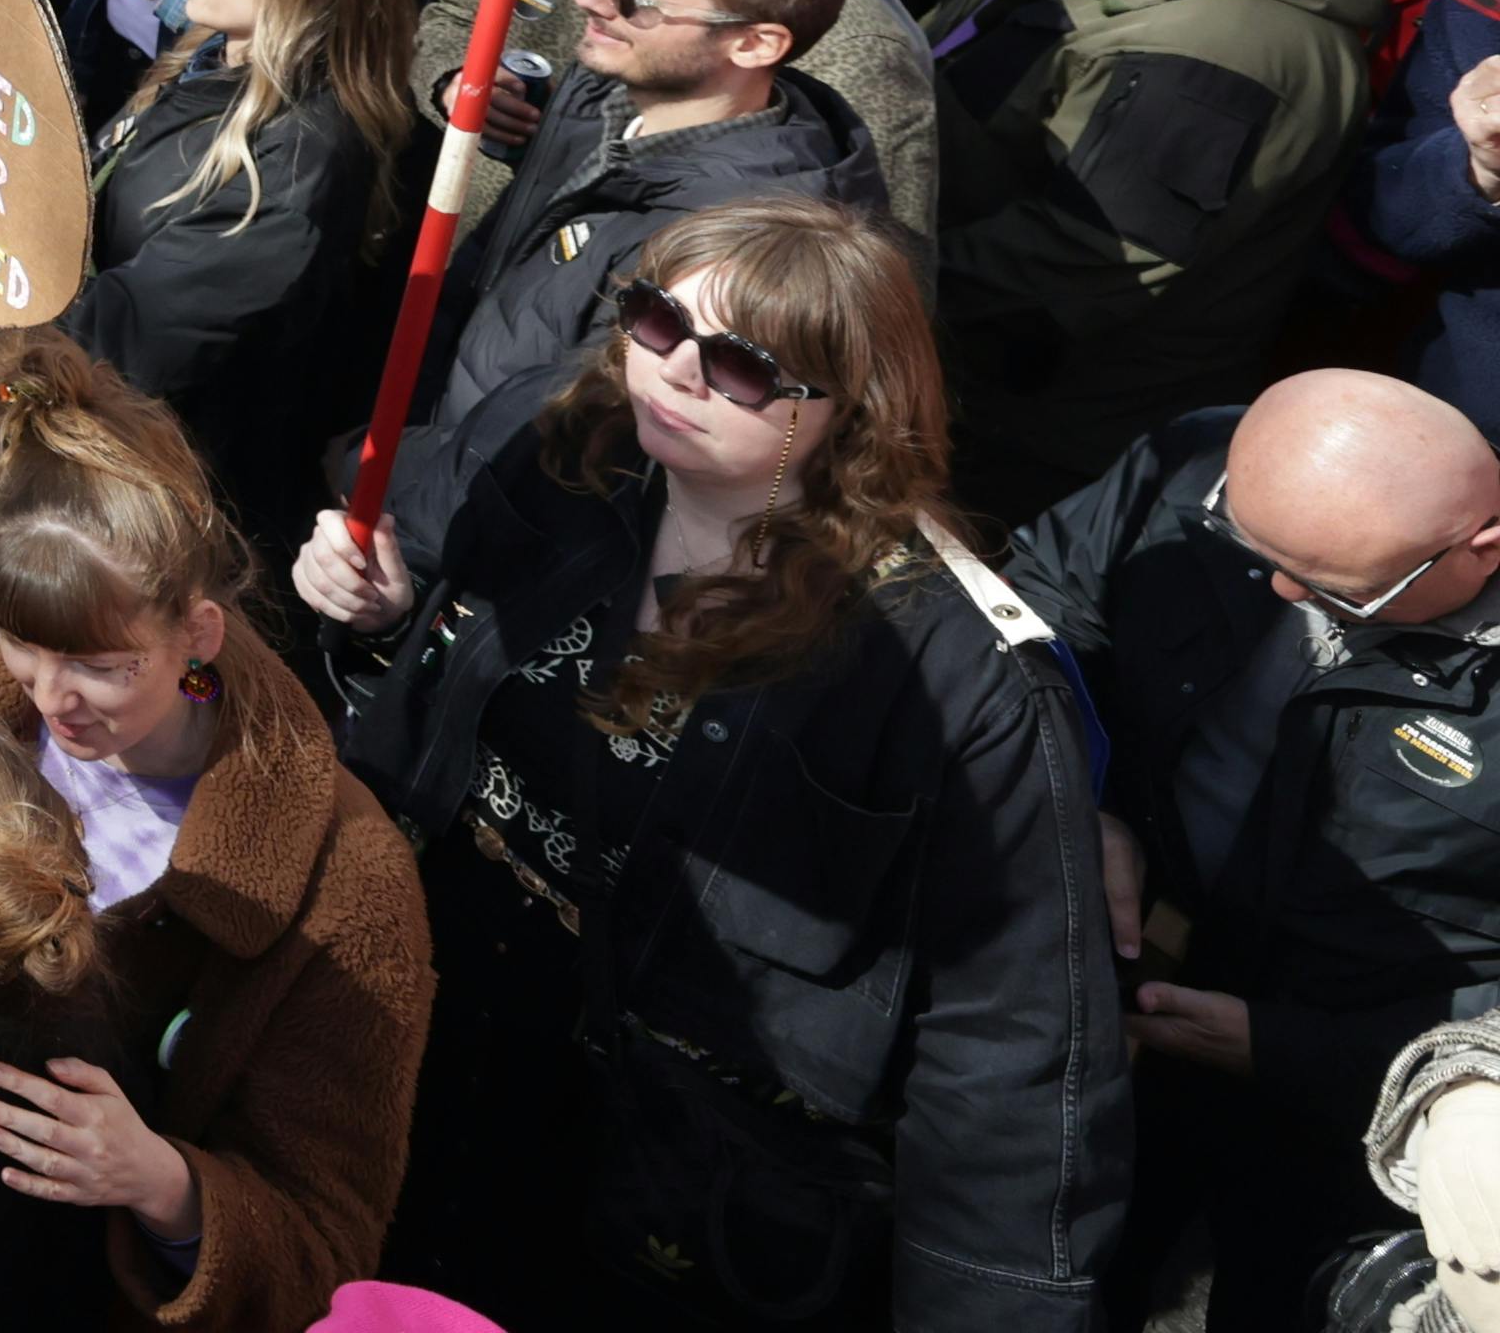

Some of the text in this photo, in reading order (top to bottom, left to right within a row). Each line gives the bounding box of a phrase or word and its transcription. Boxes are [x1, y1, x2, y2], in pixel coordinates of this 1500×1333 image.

[1401, 722, 1476, 772] I'M MARCHING
[1410, 734, 1450, 767] MARCH
